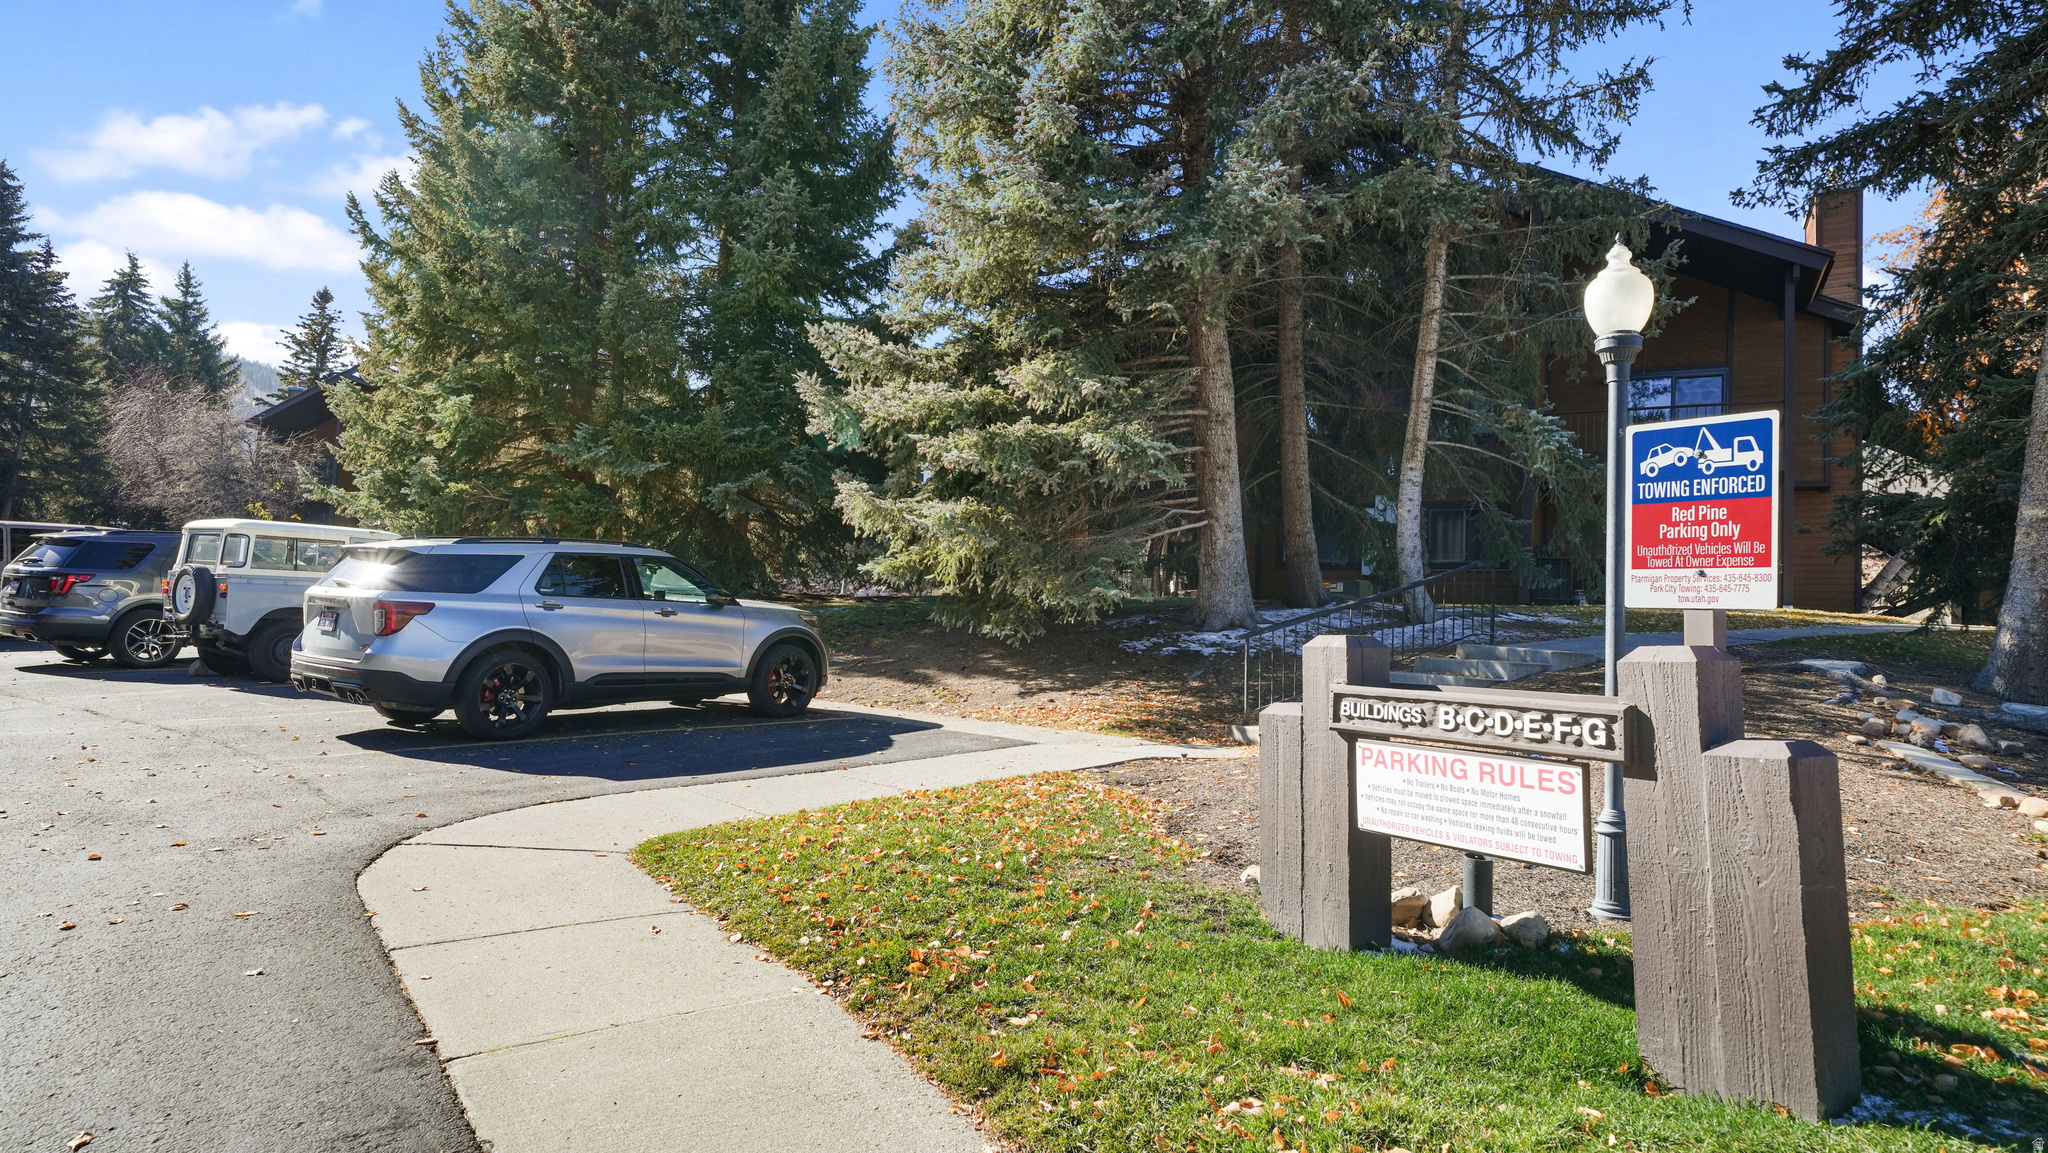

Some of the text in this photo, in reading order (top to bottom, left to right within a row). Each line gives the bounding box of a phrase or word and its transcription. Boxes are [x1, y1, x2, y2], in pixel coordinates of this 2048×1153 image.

[1637, 474, 1766, 500] TOWING ENFORCED
[1671, 504, 1727, 522] Red Pine
[1659, 520, 1741, 541] Parking Only
[1637, 541, 1766, 557] Unauthorized Vehicles Will Be
[1646, 555, 1755, 569] Towed At Owner Expense
[1631, 573, 1772, 585] Ptarmigan Property Services: 435-645-8300
[1649, 584, 1750, 594] Park City Towing: 435-645-7775
[1677, 595, 1720, 605] tow.utah.gov
[1340, 701, 1423, 724] BUILDINGS
[1361, 747, 1577, 795] PARKING RULES
[1406, 778, 1521, 802] No Trailers No Boats No Motor Homes
[1371, 783, 1392, 794] Vehicles
[1393, 787, 1406, 796] must
[1406, 789, 1414, 797] be
[1414, 790, 1433, 800] moved
[1433, 793, 1439, 801] to
[1439, 794, 1460, 805] plowed
[1461, 798, 1478, 808] space
[1479, 800, 1517, 815] immediately
[1518, 807, 1533, 816] after
[1539, 811, 1568, 821] snowfall
[1364, 793, 1578, 836] Vehicles may not occupy the same space for more than 48 consecutive hours
[1380, 806, 1388, 814] No
[1388, 808, 1404, 817] repair
[1410, 812, 1420, 820] car
[1420, 813, 1443, 825] washing
[1448, 818, 1472, 829] Vehicles
[1473, 822, 1495, 835] leaking
[1496, 825, 1513, 837] fluids
[1514, 829, 1526, 839] will
[1527, 831, 1536, 841] be
[1536, 833, 1557, 844] towed
[1362, 816, 1578, 864] UNAUTHORIZED VEHICLES & VIOLATORS SUBJECT TO TOWING
